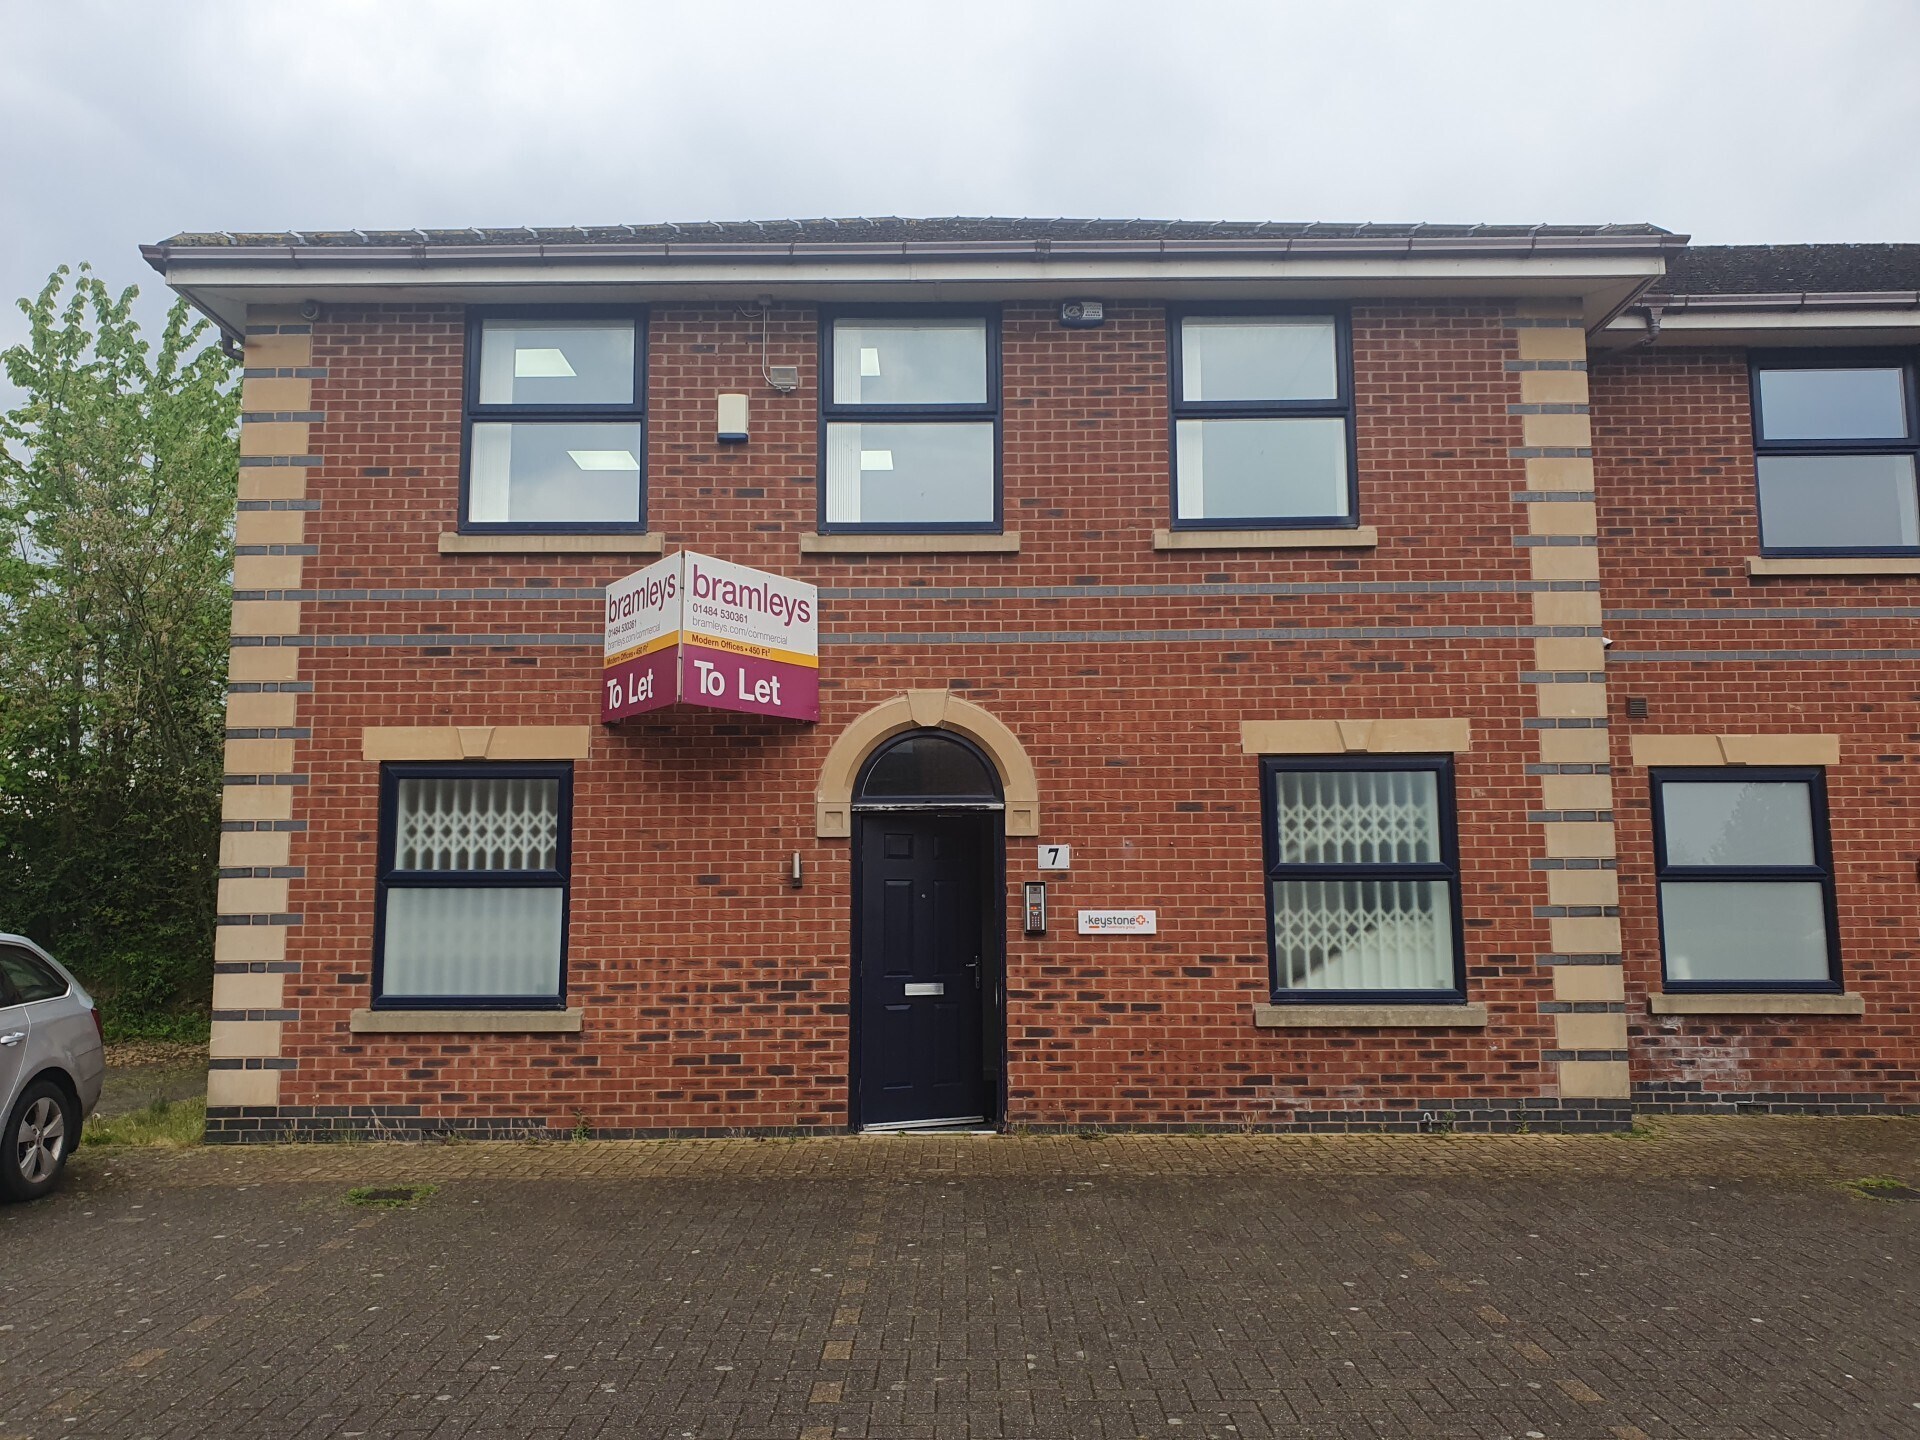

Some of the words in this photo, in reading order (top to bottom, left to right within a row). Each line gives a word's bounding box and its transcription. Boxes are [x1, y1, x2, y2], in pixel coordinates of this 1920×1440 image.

[609, 574, 676, 624] bramleys
[693, 564, 811, 627] bramleys
[692, 603, 718, 617] 01484
[720, 609, 748, 624] 530361
[691, 634, 719, 647] Modern
[720, 640, 744, 652] Offices
[748, 645, 760, 655] 450
[692, 616, 788, 645] bramleys.com/commercial
[607, 678, 622, 709] To
[628, 668, 654, 704] Let
[693, 660, 726, 697] To
[738, 668, 781, 706] Let
[1048, 848, 1059, 865] 7
[1088, 915, 1136, 928] keystone
